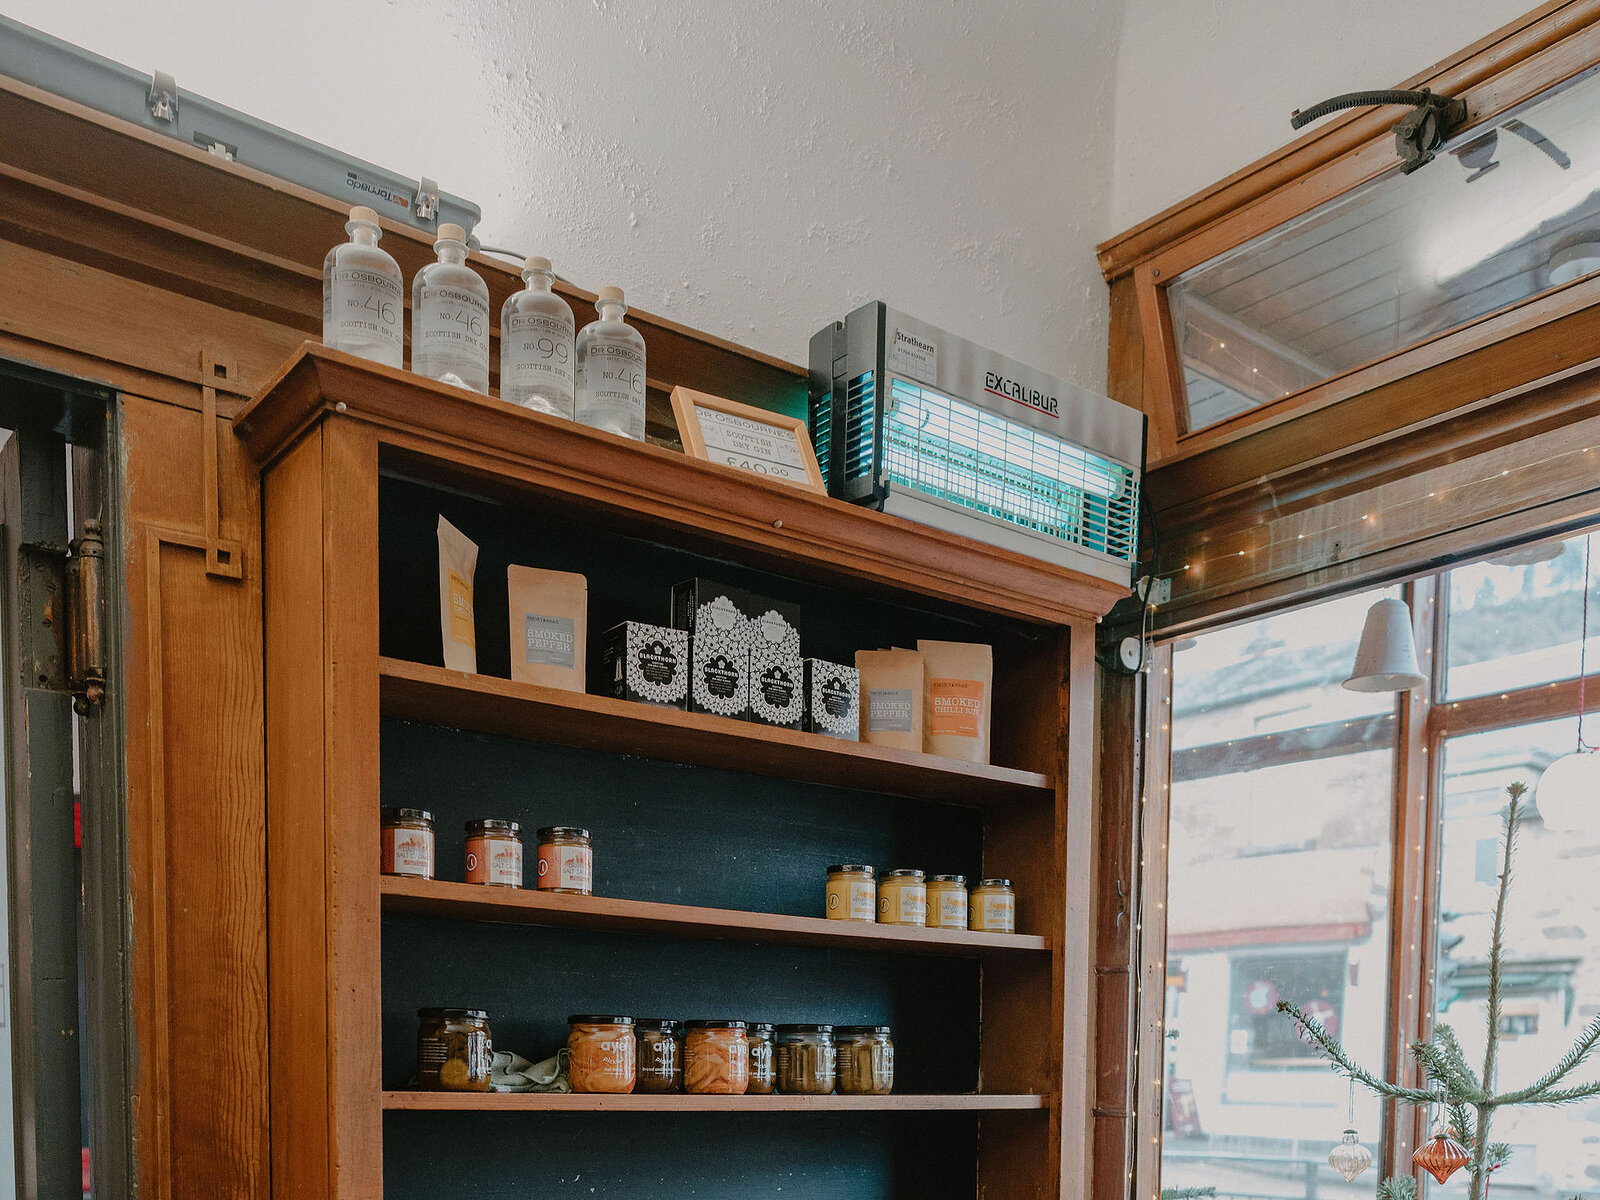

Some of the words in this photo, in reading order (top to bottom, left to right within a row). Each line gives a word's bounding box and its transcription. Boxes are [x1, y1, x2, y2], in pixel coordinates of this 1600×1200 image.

[347, 179, 392, 201] Tornado
[512, 318, 525, 326] DR
[340, 320, 378, 331] SCOTTISH
[381, 327, 393, 338] DRY
[425, 330, 461, 339] SCOTTISH
[465, 335, 478, 346] DRY
[896, 332, 934, 353] Strathearn
[591, 346, 604, 355] DR
[516, 364, 552, 373] SCOTTISH
[595, 391, 629, 401] SCOTTISH
[985, 371, 1059, 415] EXCALIBUR
[714, 414, 795, 440] OSBOURNE'S
[726, 429, 773, 448] SCOTTISH
[732, 440, 750, 451] DRY
[753, 446, 772, 456] GIN
[527, 628, 573, 643] SMOKED
[527, 638, 570, 652] PEPPER
[639, 653, 676, 663] BLACKTHORN
[705, 667, 739, 678] BLACKTHORN
[761, 676, 794, 688] BLACKTHORN
[822, 687, 851, 698] BLACKTHORN
[870, 702, 911, 710] SMOKED
[934, 697, 980, 708] SMOKED
[870, 710, 909, 718] PEPPER
[934, 706, 962, 714] CHILLI
[601, 1041, 626, 1053] aye
[653, 1042, 676, 1053] aye
[729, 1045, 747, 1056] aye
